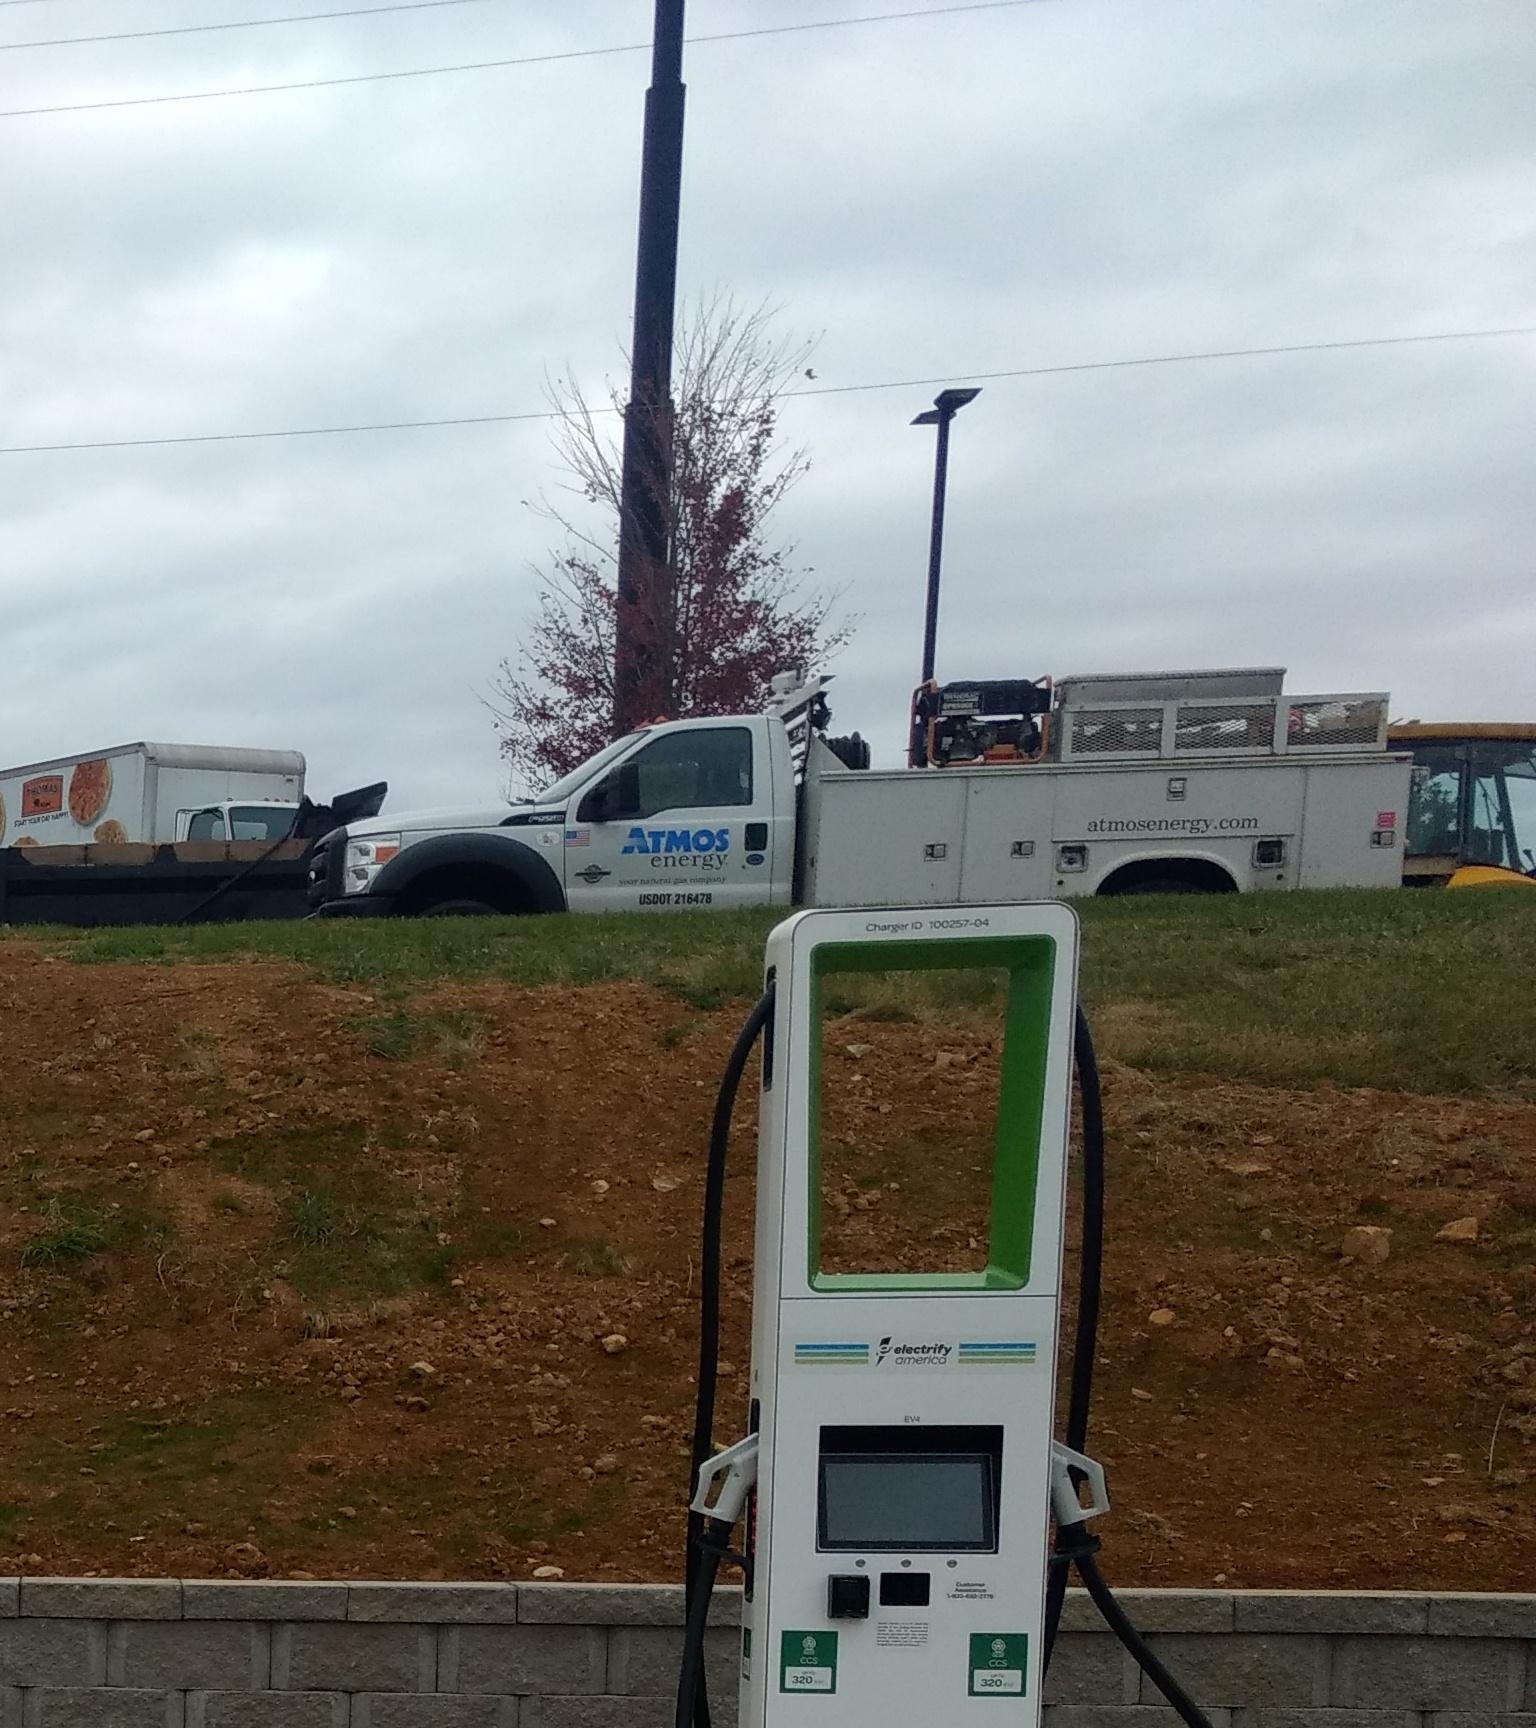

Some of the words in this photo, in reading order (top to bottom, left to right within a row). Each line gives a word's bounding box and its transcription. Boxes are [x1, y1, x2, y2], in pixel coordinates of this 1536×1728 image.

[1087, 816, 1259, 834] atmosenergy.com
[621, 827, 730, 854] ATMOS
[650, 854, 728, 871] energy
[639, 893, 672, 905] USDOT
[866, 923, 908, 934] Charger
[911, 921, 923, 930] ID
[929, 918, 990, 930] 100257-04
[893, 1344, 953, 1356] electrify
[895, 1355, 947, 1365] america
[799, 1656, 818, 1664] CCS
[988, 1659, 1008, 1667] CCS
[791, 1676, 813, 1684] 320
[980, 1678, 1002, 1687] 320
